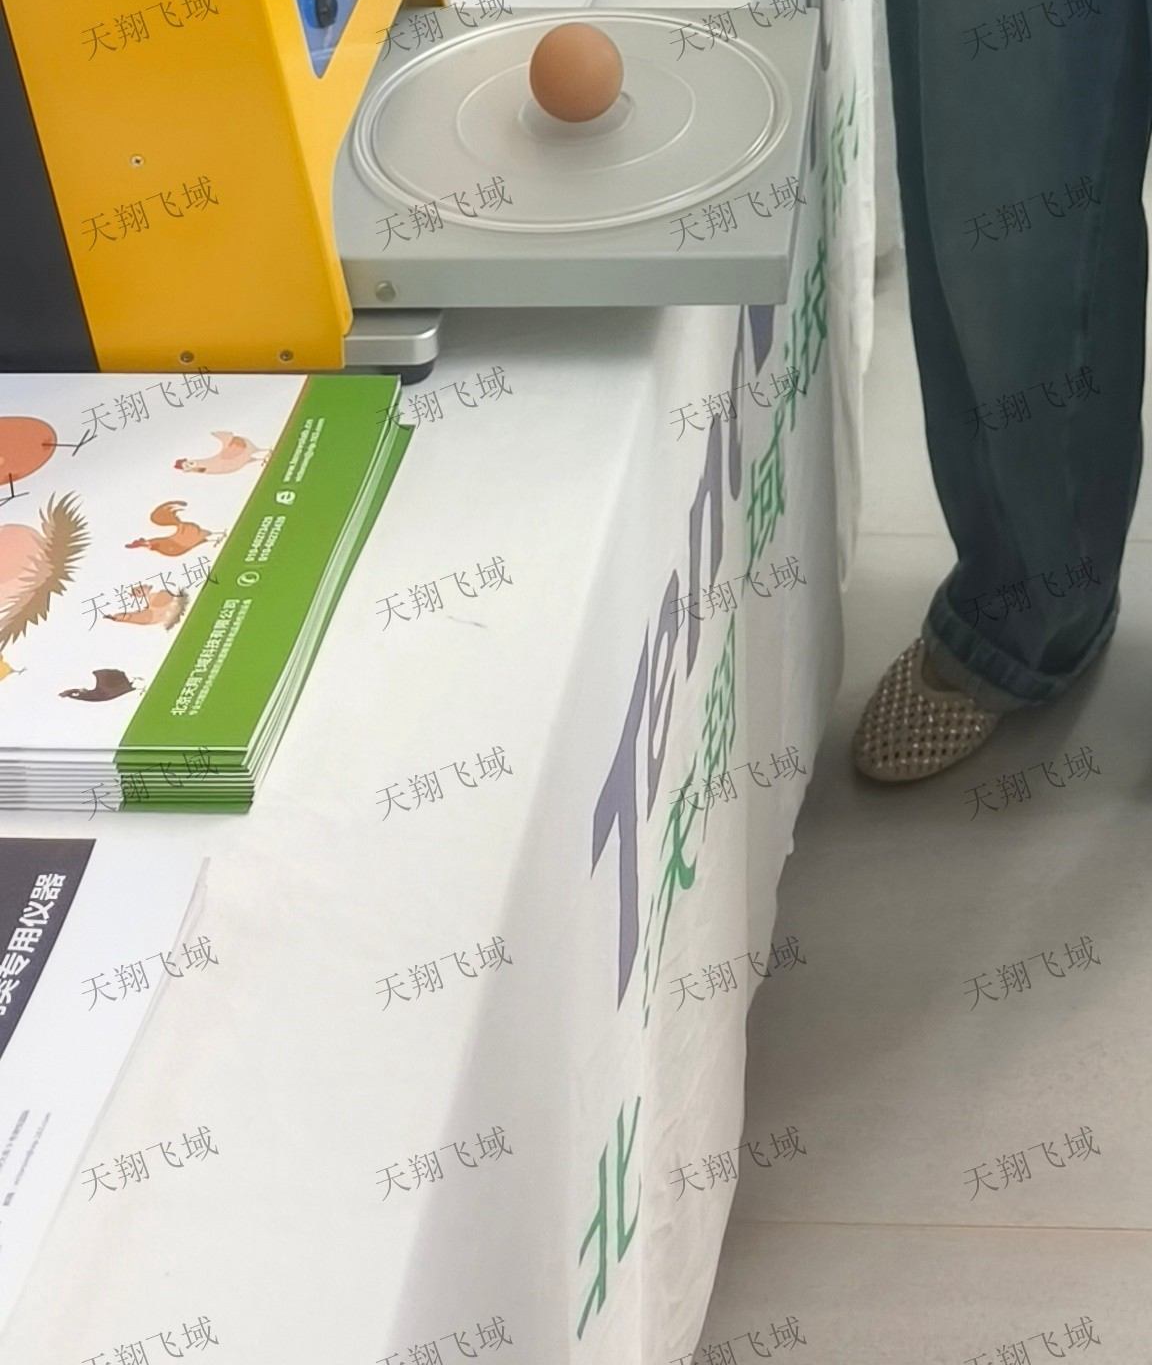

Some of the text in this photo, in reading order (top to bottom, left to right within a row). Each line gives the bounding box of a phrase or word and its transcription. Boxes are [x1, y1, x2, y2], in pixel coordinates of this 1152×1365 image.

[0, 873, 67, 1016] 类专用仪器
